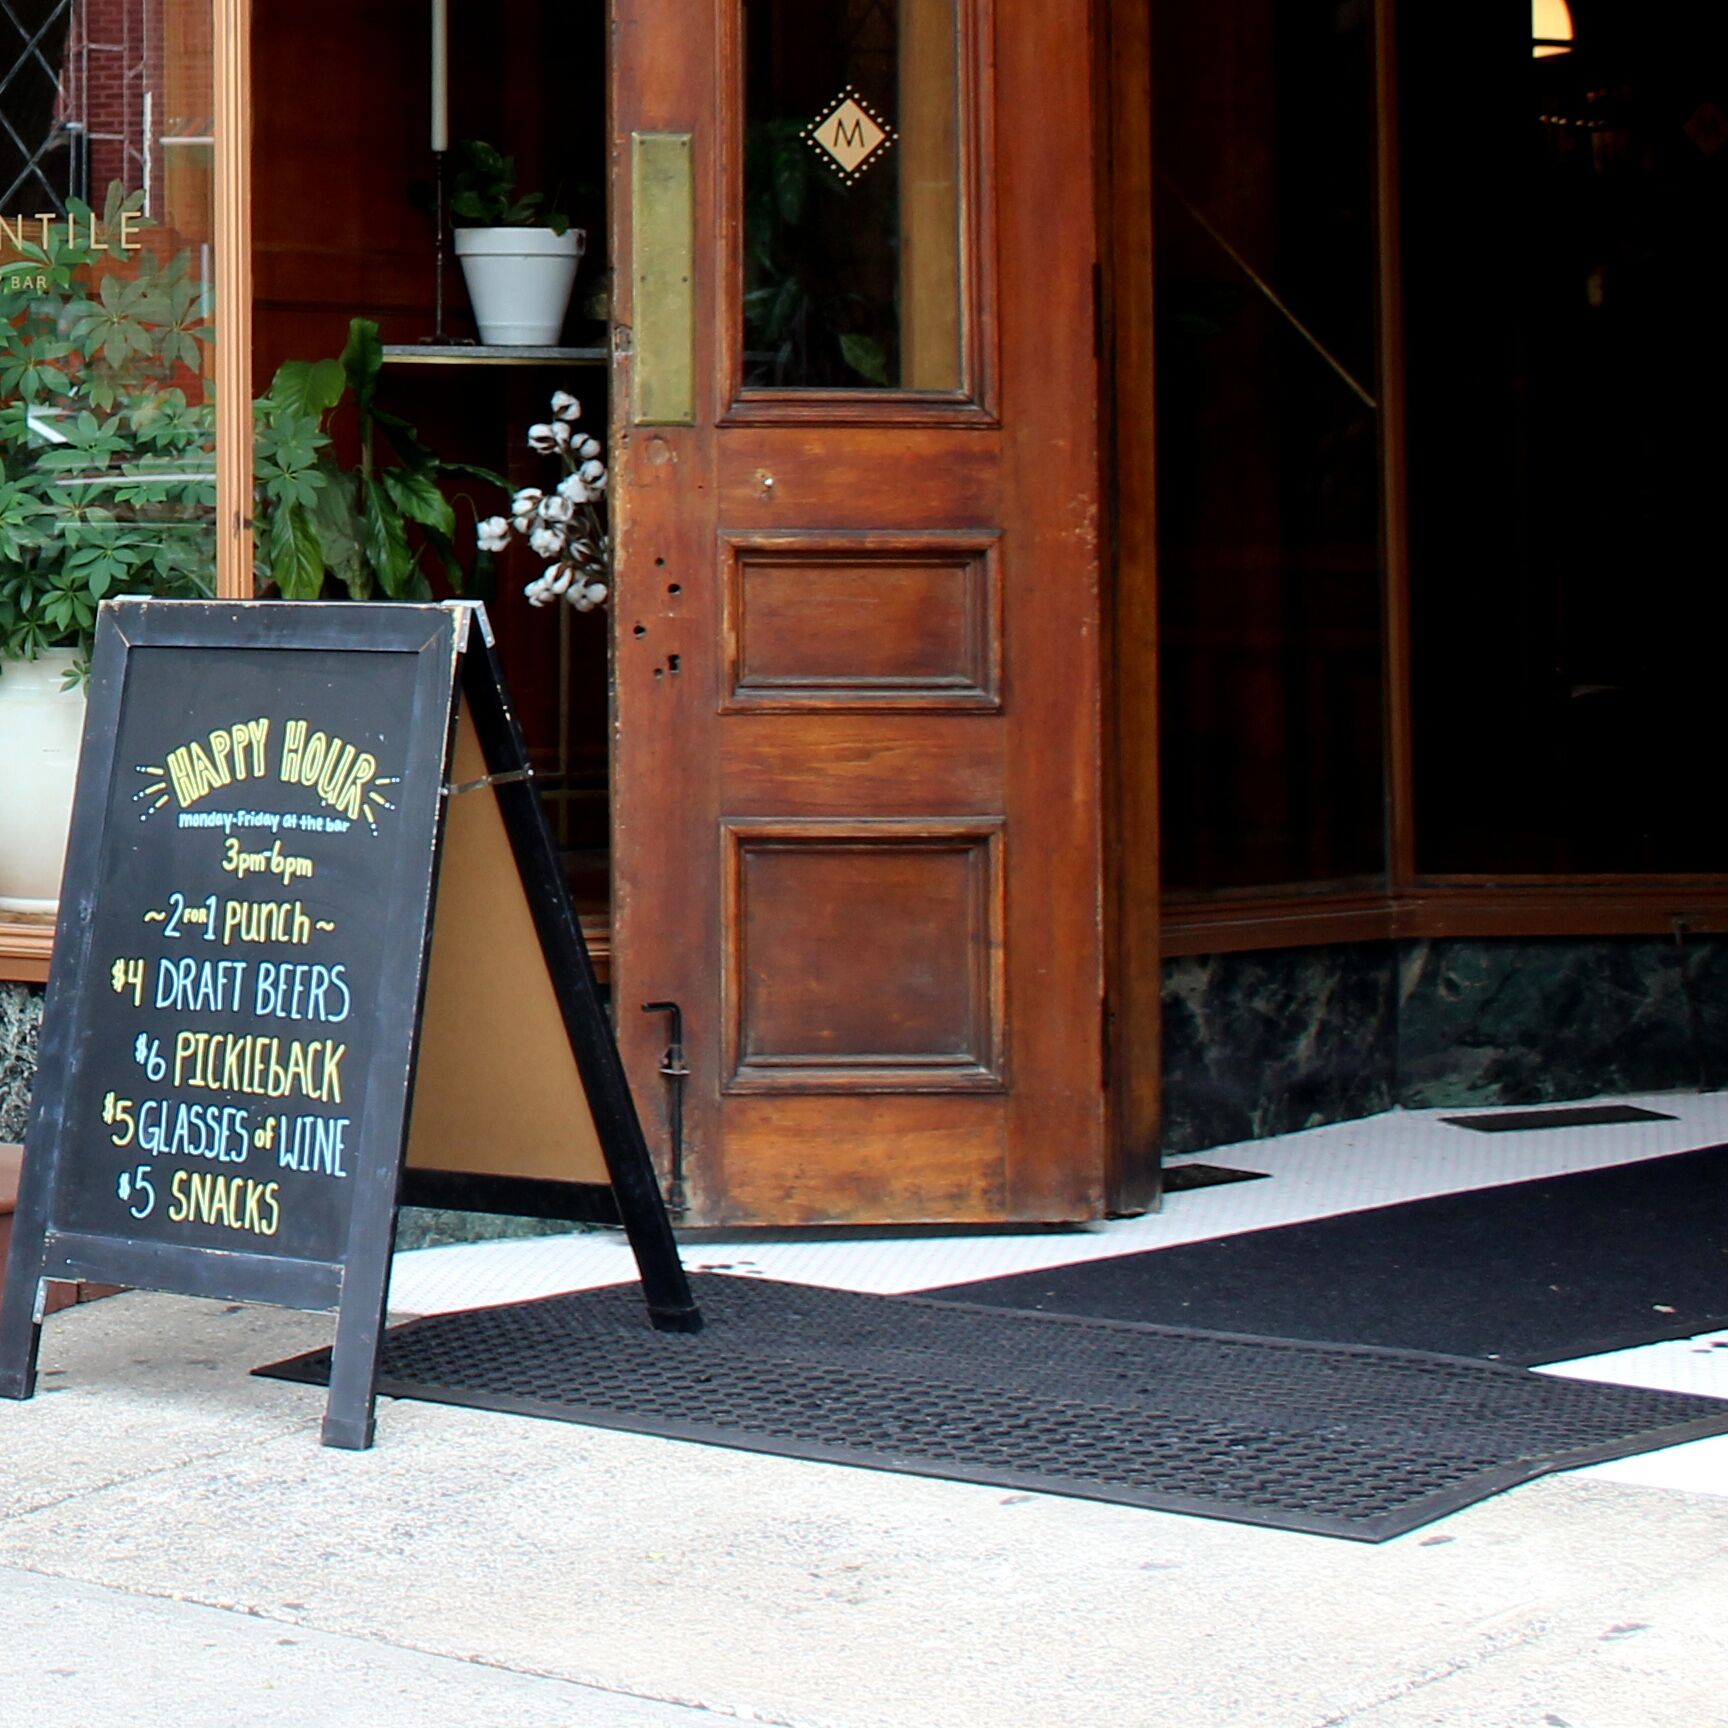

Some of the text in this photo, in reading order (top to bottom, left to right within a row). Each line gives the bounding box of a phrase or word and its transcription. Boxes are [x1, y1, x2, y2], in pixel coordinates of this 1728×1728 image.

[833, 118, 865, 148] M
[11, 275, 47, 289] BAR
[166, 718, 376, 820] HAPPY HOUR
[282, 815, 299, 828] at
[299, 815, 323, 832] the
[325, 817, 350, 832] bar
[110, 958, 350, 1022] $4 DRAFT BEERS
[134, 1033, 167, 1081] $6
[102, 1091, 350, 1177] $5 GLASSES of WINE
[117, 1166, 280, 1235] $5 SNACKS
